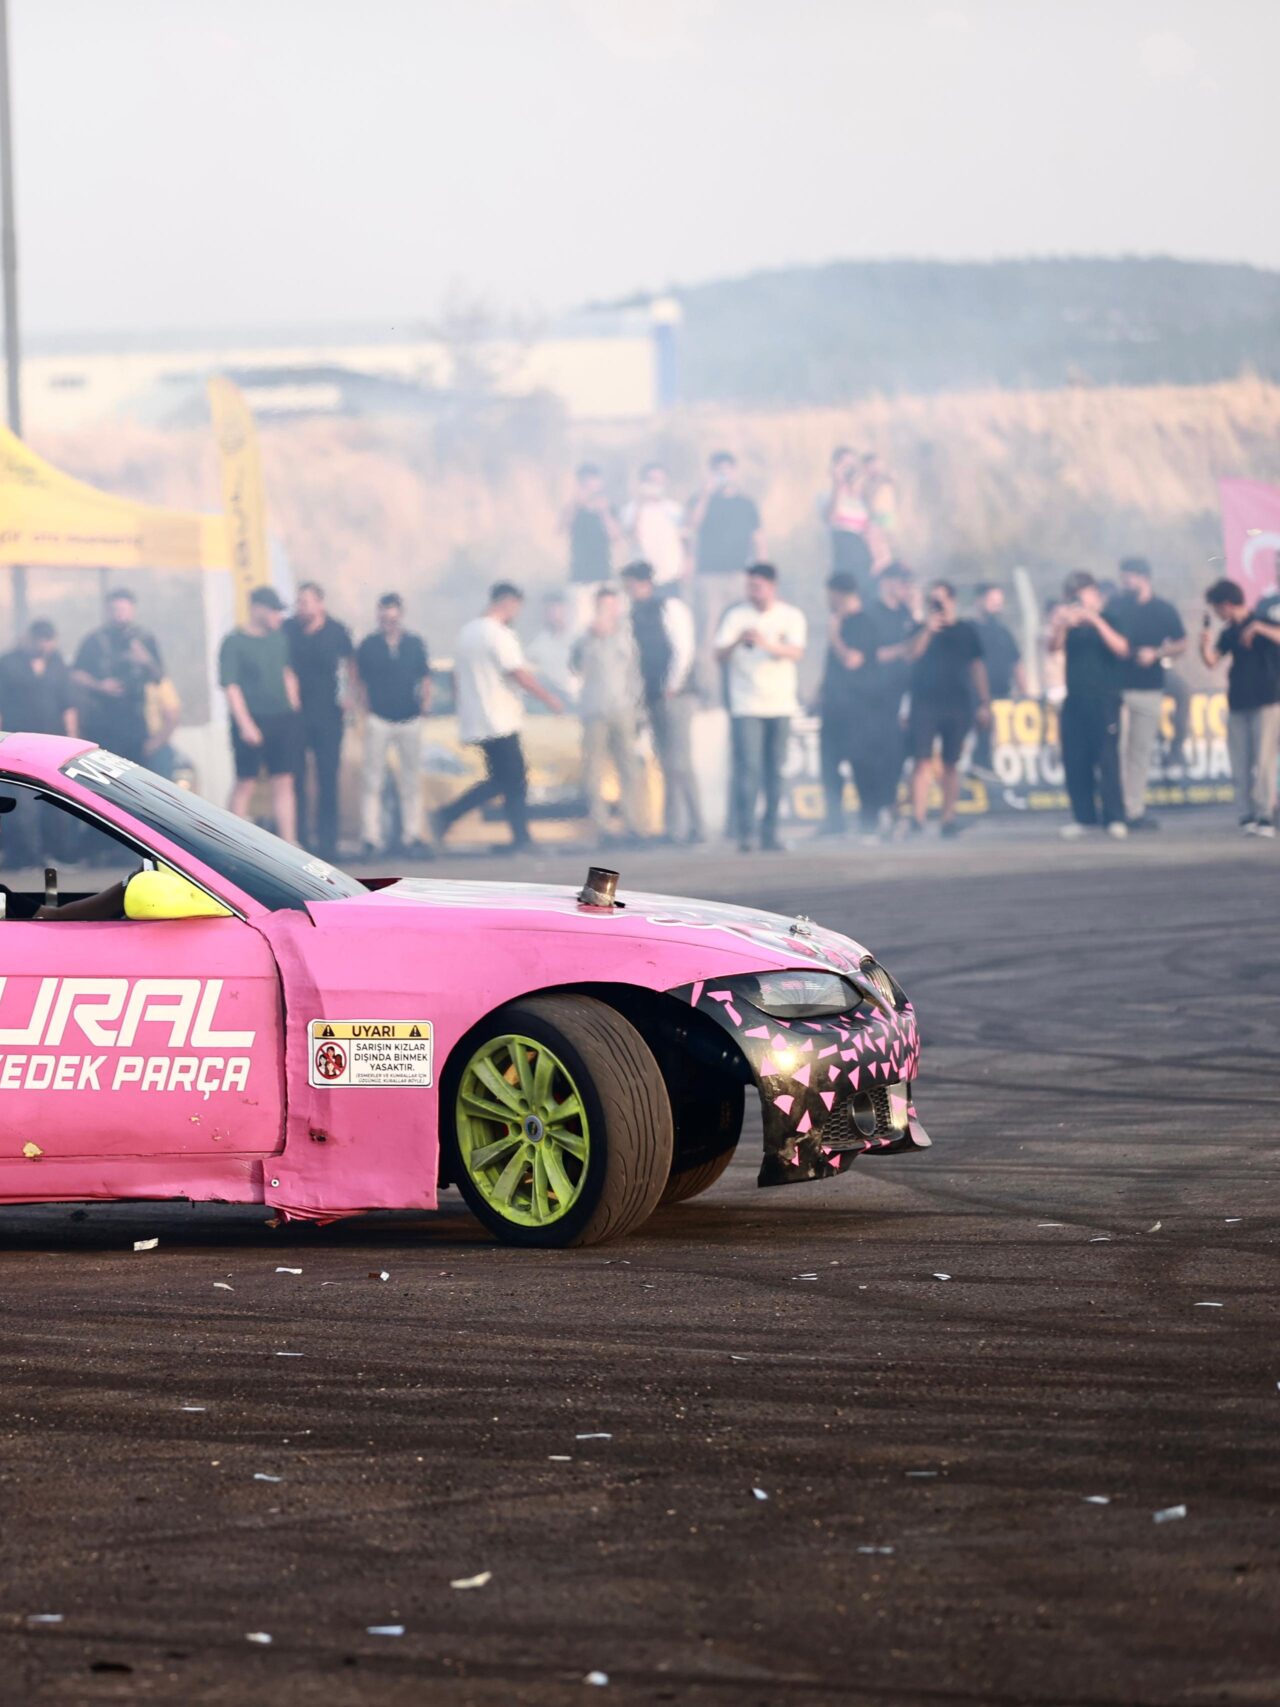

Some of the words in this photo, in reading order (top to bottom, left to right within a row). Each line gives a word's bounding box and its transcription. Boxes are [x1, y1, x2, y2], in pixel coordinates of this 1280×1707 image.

[352, 1025, 395, 1037] UYARI
[356, 1043, 391, 1053] SARIŞIN
[394, 1043, 426, 1051] KIZLAR
[354, 1053, 391, 1062] DIŞINDA
[394, 1052, 428, 1061] BİNMEK
[370, 1063, 415, 1071] YASAKTIR.
[111, 1056, 251, 1101] PARÇA
